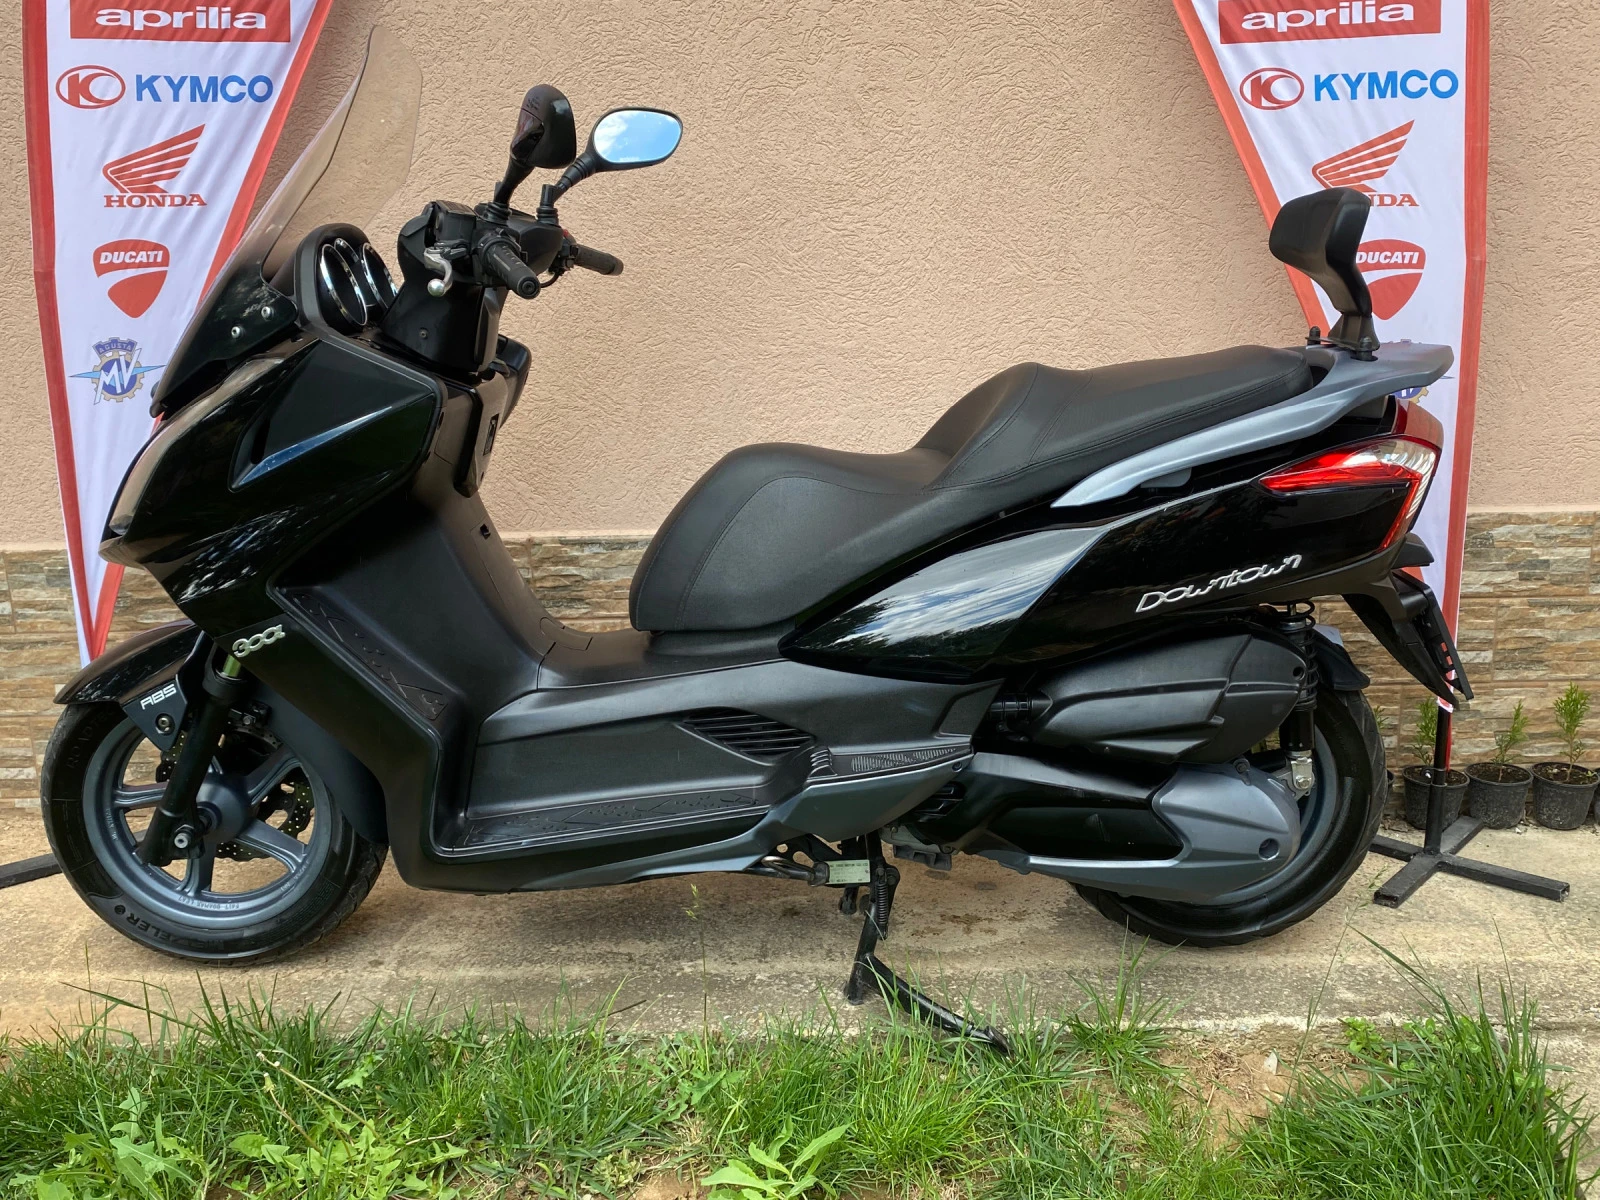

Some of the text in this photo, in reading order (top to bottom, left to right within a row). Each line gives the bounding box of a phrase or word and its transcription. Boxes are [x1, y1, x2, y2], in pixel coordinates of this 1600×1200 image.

[95, 6, 266, 31] aprilia
[1241, 0, 1414, 32] aprilia
[135, 74, 274, 103] KYMCO
[1314, 69, 1459, 102] KYMCO
[103, 193, 208, 208] HONDA
[99, 251, 164, 264] DUCATI
[1356, 251, 1419, 265] DUCATI
[98, 342, 132, 353] AGUSTA
[94, 347, 142, 405] MV
[1136, 554, 1302, 613] Downtown
[140, 683, 177, 710] ABS
